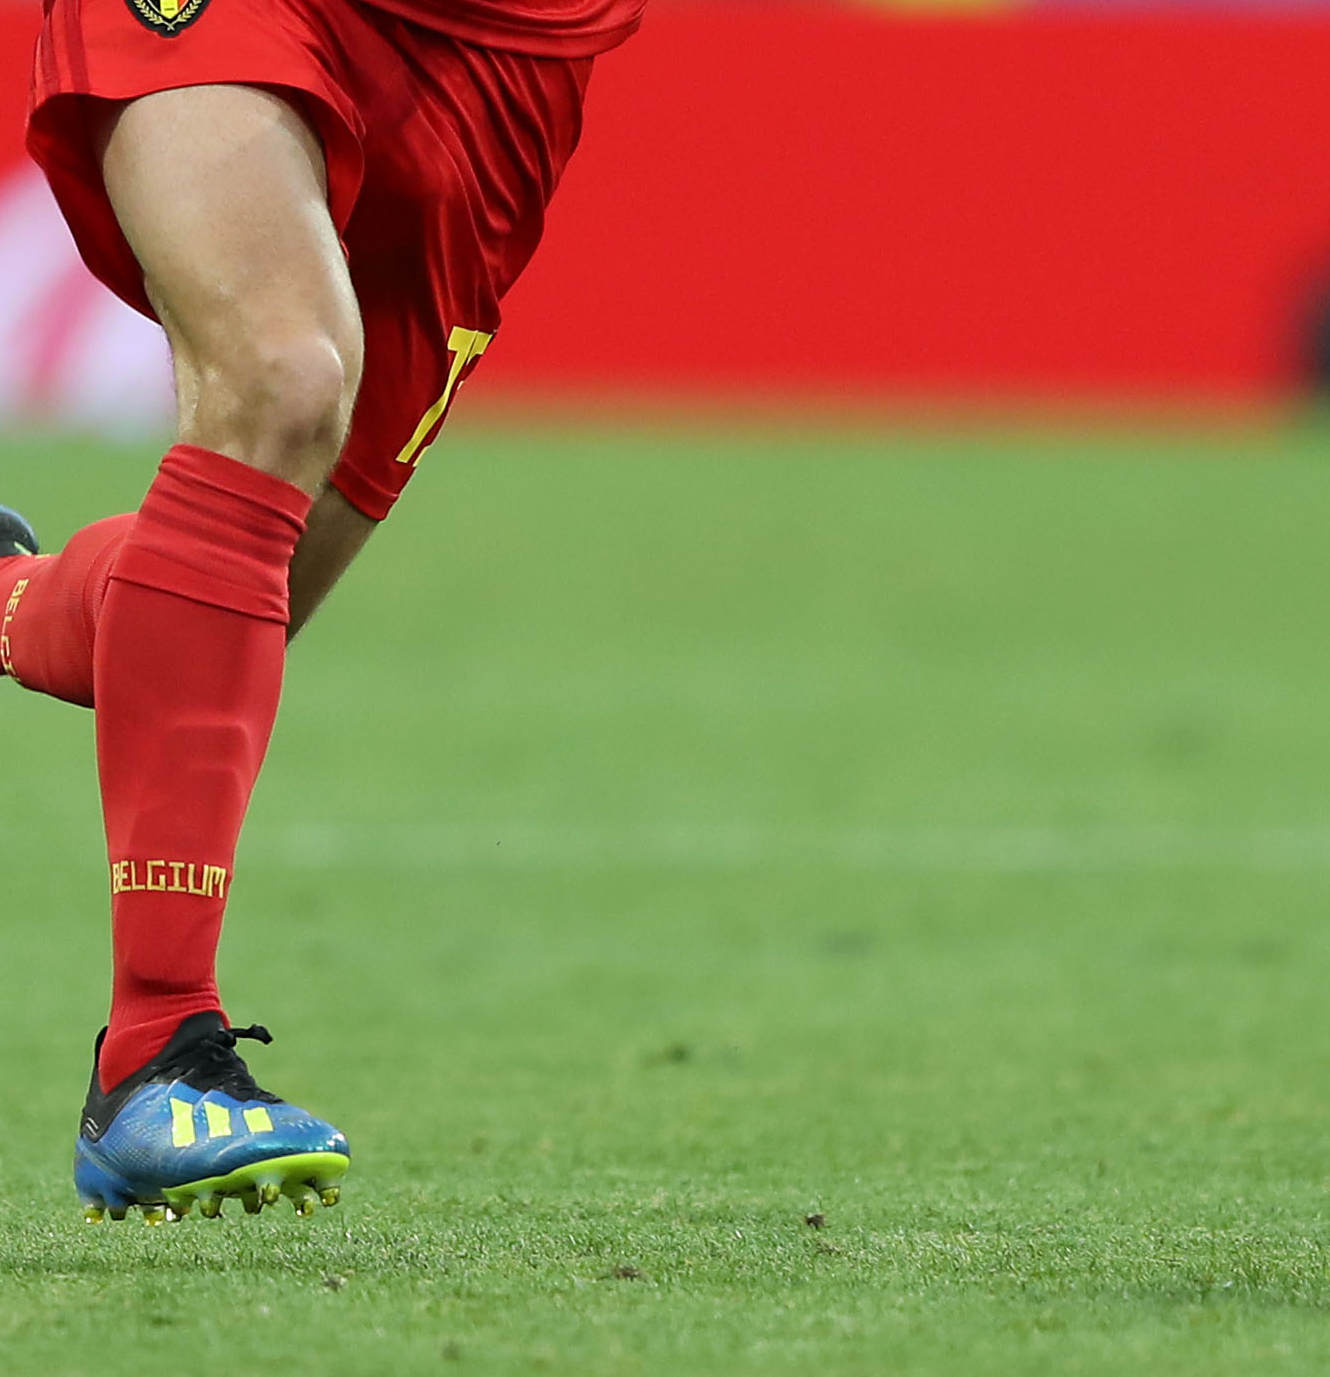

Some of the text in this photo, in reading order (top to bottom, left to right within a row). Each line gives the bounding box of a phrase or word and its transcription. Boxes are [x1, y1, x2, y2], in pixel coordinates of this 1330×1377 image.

[395, 325, 498, 467] 1
[0, 578, 30, 683] BELGI
[112, 859, 227, 898] BELGIUM
